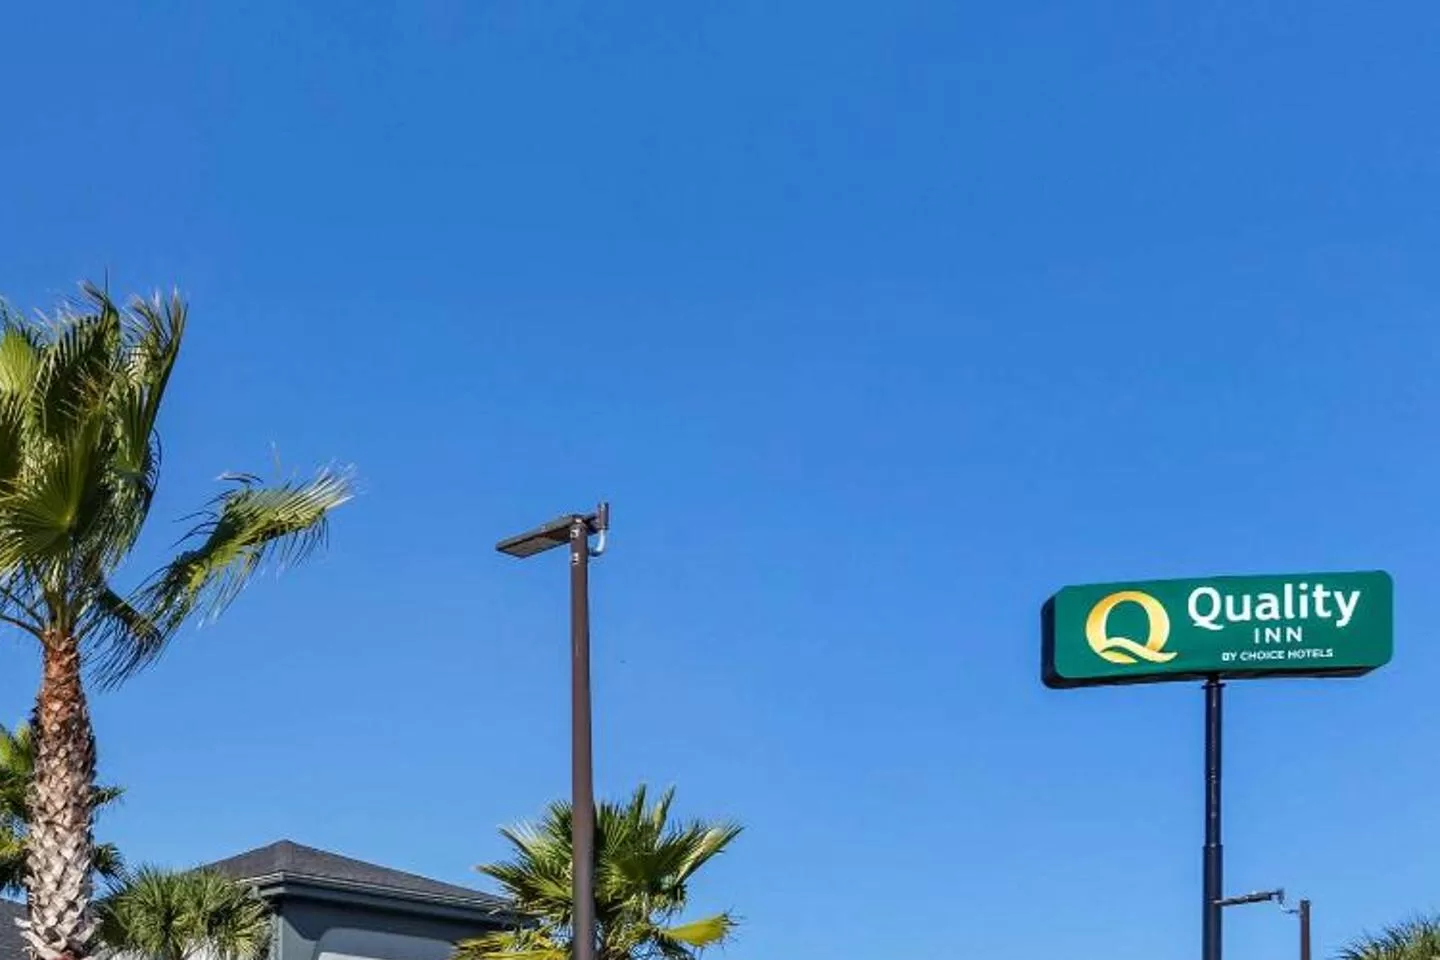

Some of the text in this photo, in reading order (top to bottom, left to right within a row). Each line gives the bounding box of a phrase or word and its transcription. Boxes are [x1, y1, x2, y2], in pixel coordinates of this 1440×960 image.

[1187, 582, 1361, 631] Quality
[1253, 626, 1303, 644] INN
[1221, 648, 1334, 662] BY CHOICE HOTELS
